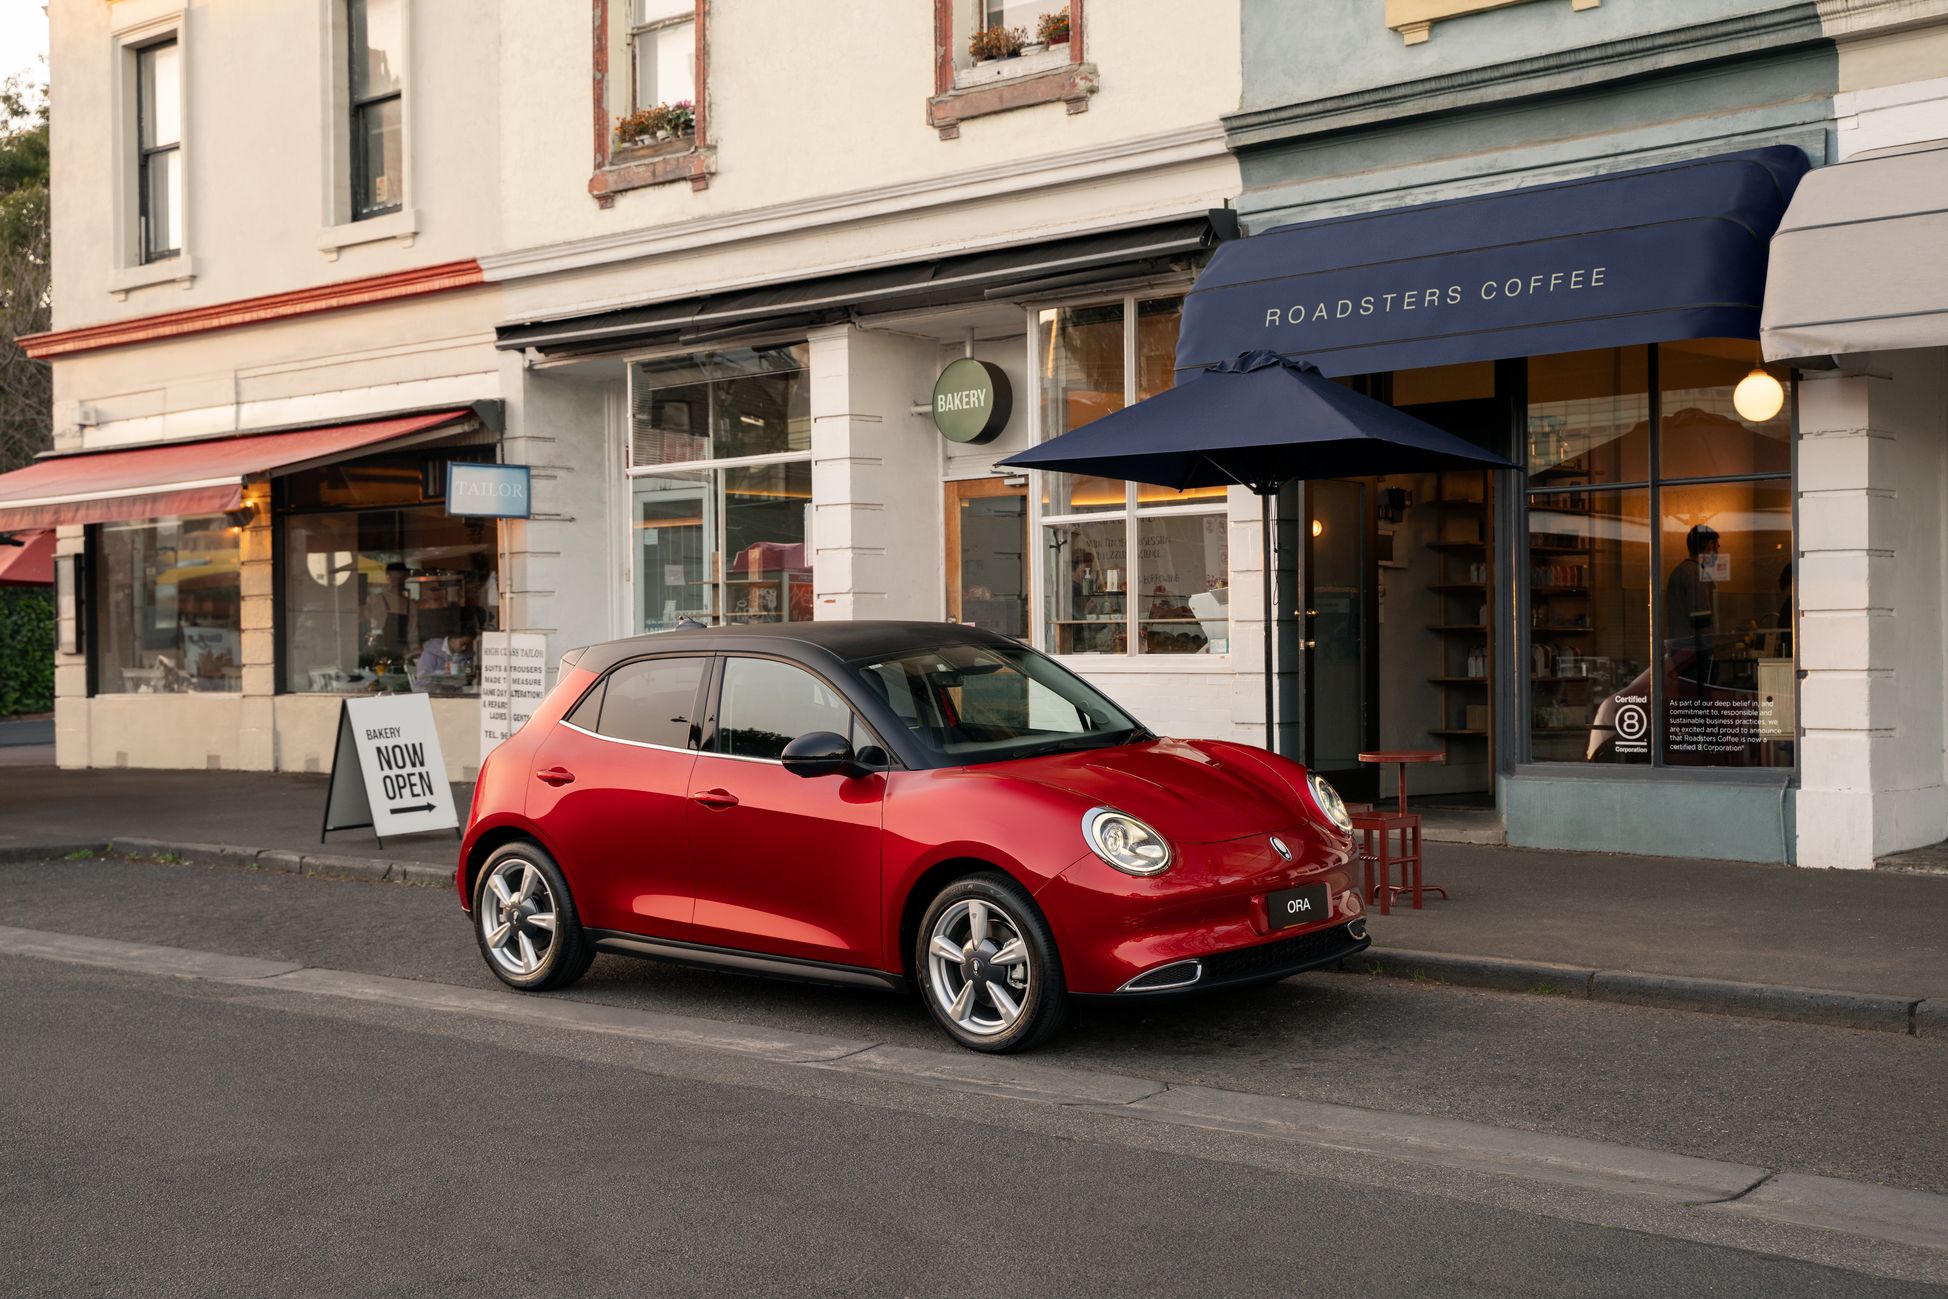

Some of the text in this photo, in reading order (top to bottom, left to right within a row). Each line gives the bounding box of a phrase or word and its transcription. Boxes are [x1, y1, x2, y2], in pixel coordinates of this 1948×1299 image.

[1265, 267, 1606, 328] ROADSTERS COFFEE
[937, 388, 987, 412] BAKERY
[455, 479, 523, 498] TAILOR
[483, 647, 544, 658] HIGH CLSS TAILOR
[484, 664, 502, 672] SUITS
[509, 665, 543, 674] TROUSERS
[484, 675, 501, 684] MADE
[512, 677, 542, 686] MEASURE
[482, 687, 496, 696] SAME
[497, 688, 507, 697] DAY
[1614, 695, 1647, 704] Certified
[1679, 700, 1692, 708] part
[1714, 700, 1730, 708] deep
[489, 711, 507, 720] LADIES
[1721, 709, 1758, 717] responsible
[365, 727, 401, 741] BAKERY
[1720, 727, 1739, 735] proud
[1614, 746, 1648, 754] Corporation
[375, 742, 425, 772] NOW
[382, 771, 434, 801] OPEN
[1287, 897, 1311, 914] ORA
